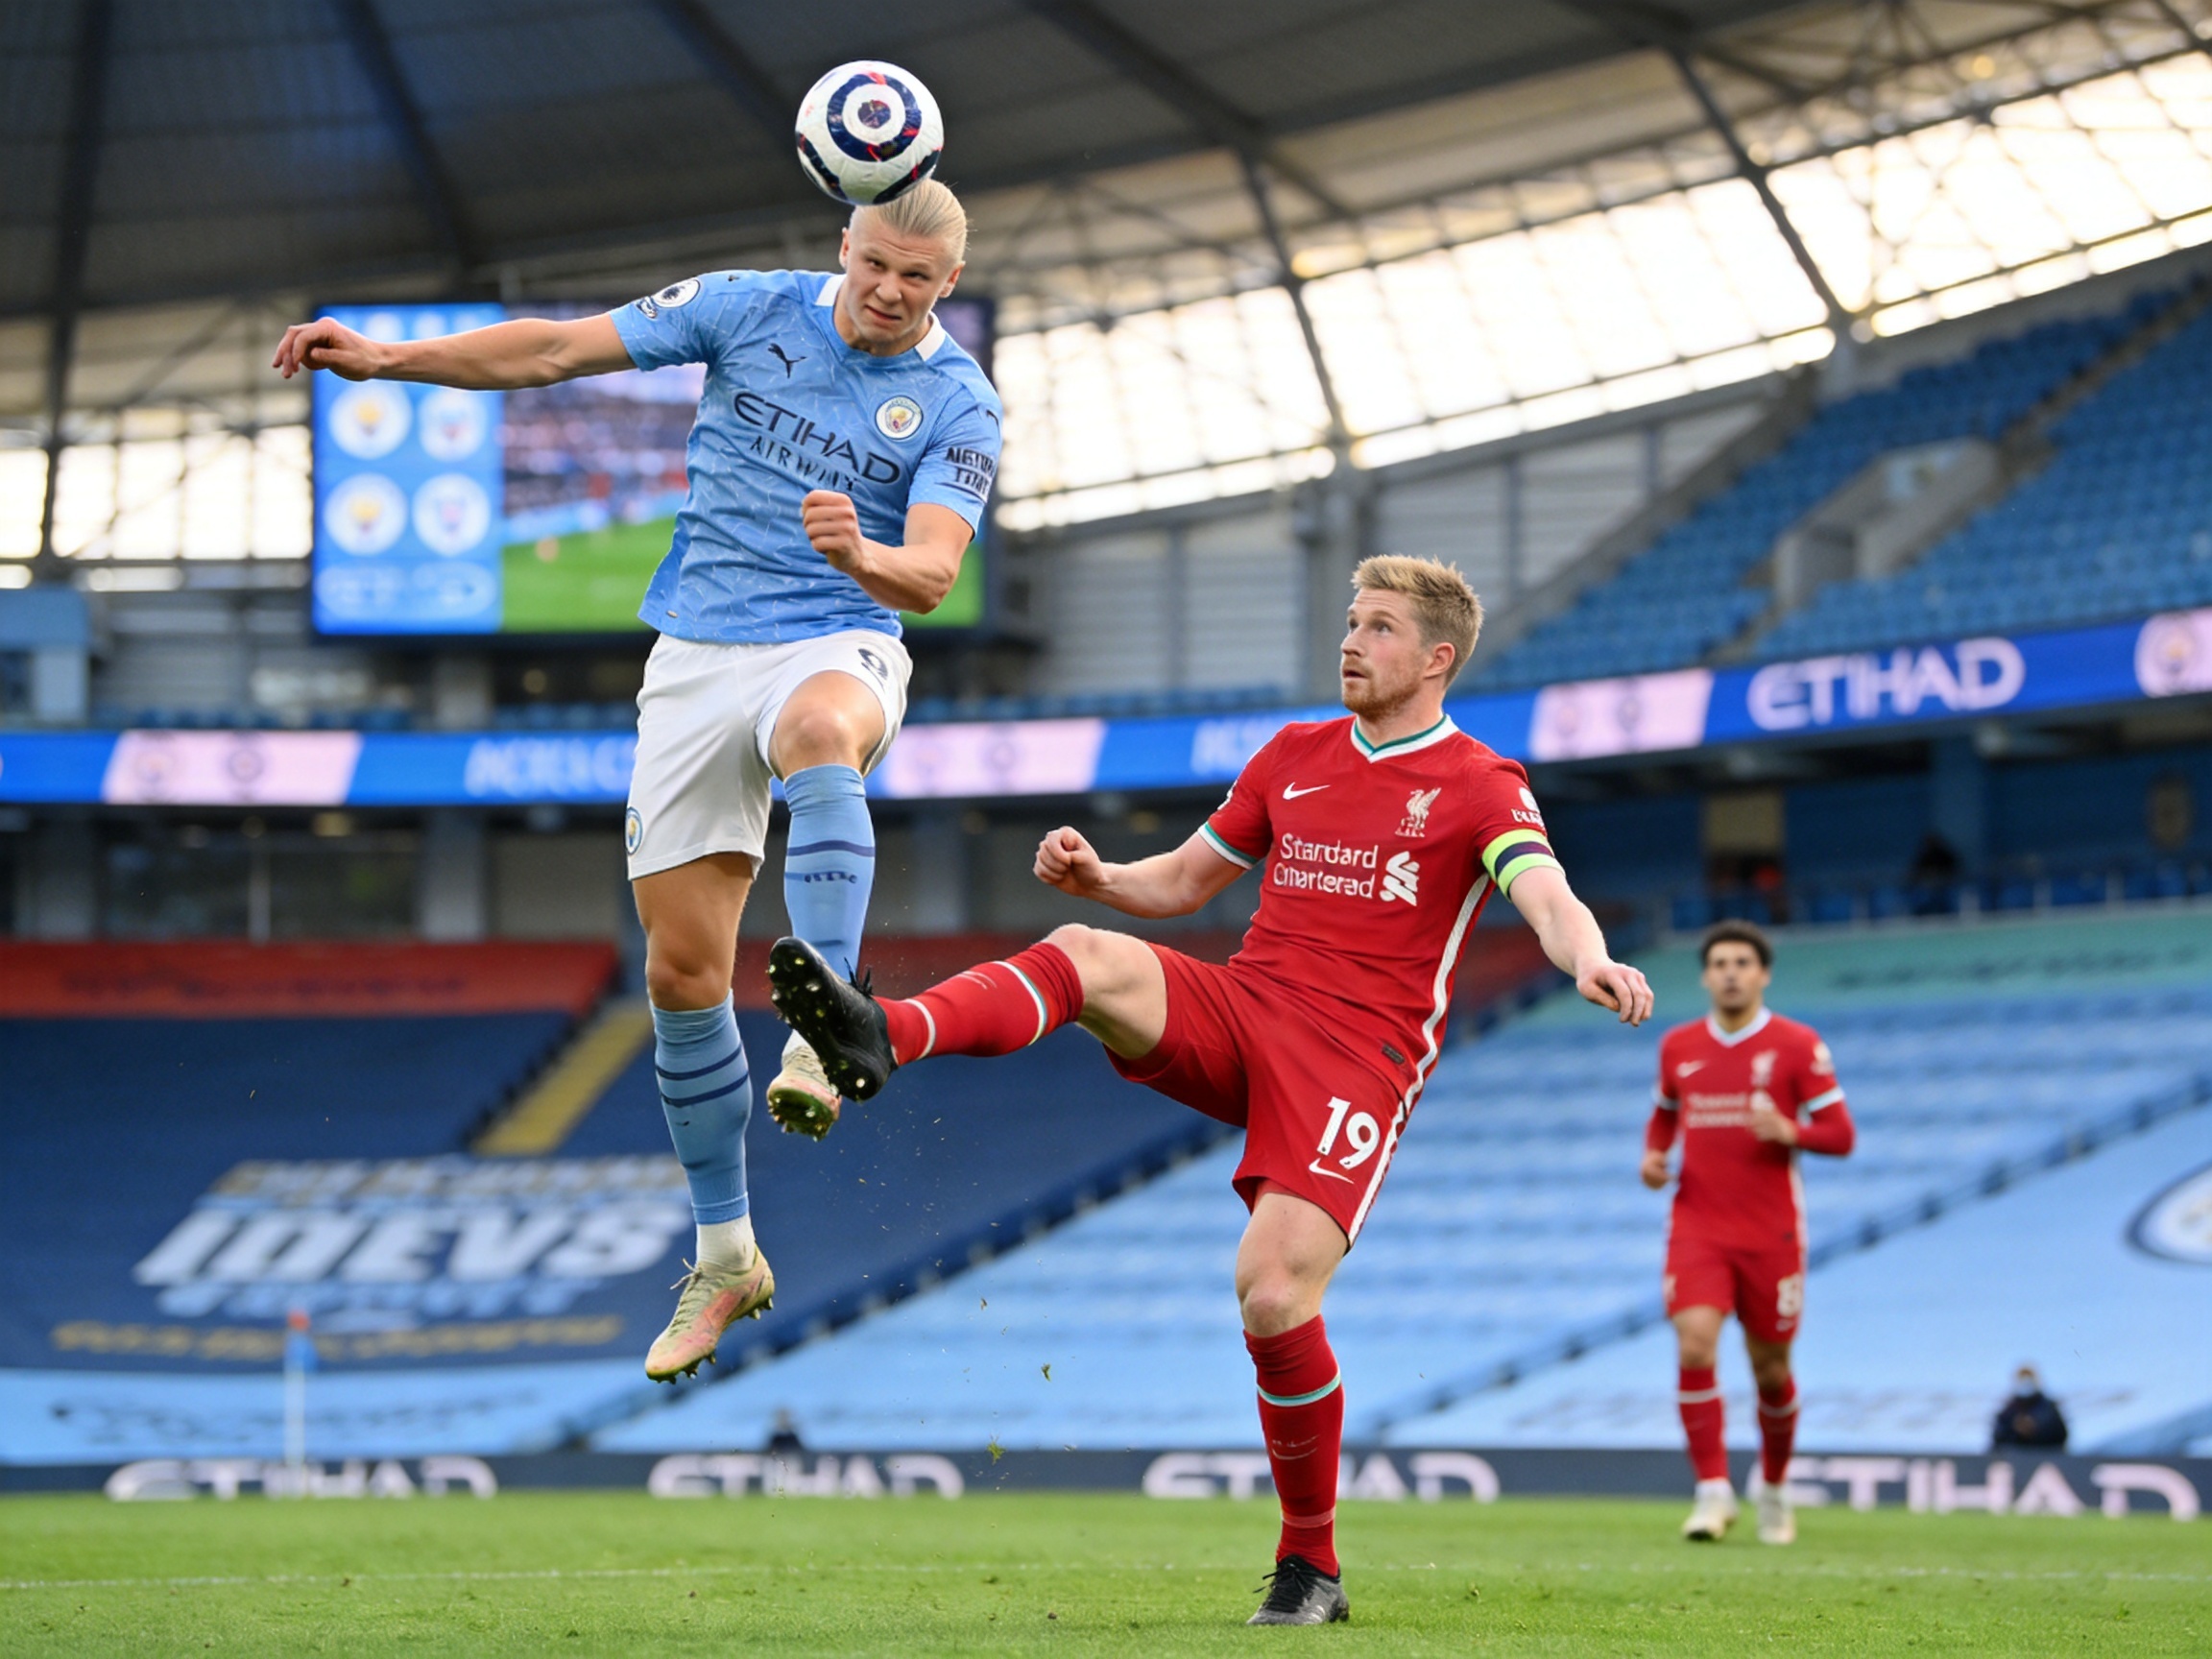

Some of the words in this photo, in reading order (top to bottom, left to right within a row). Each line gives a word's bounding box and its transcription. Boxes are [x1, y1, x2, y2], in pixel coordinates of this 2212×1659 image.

[734, 393, 901, 484] ETIHAD
[1746, 636, 2026, 732] ETIHAD
[1316, 1095, 1380, 1170] 19
[647, 1454, 965, 1501] ETIHAD
[1142, 1452, 1500, 1503] ETAD
[1744, 1456, 2201, 1522] ETIHAD
